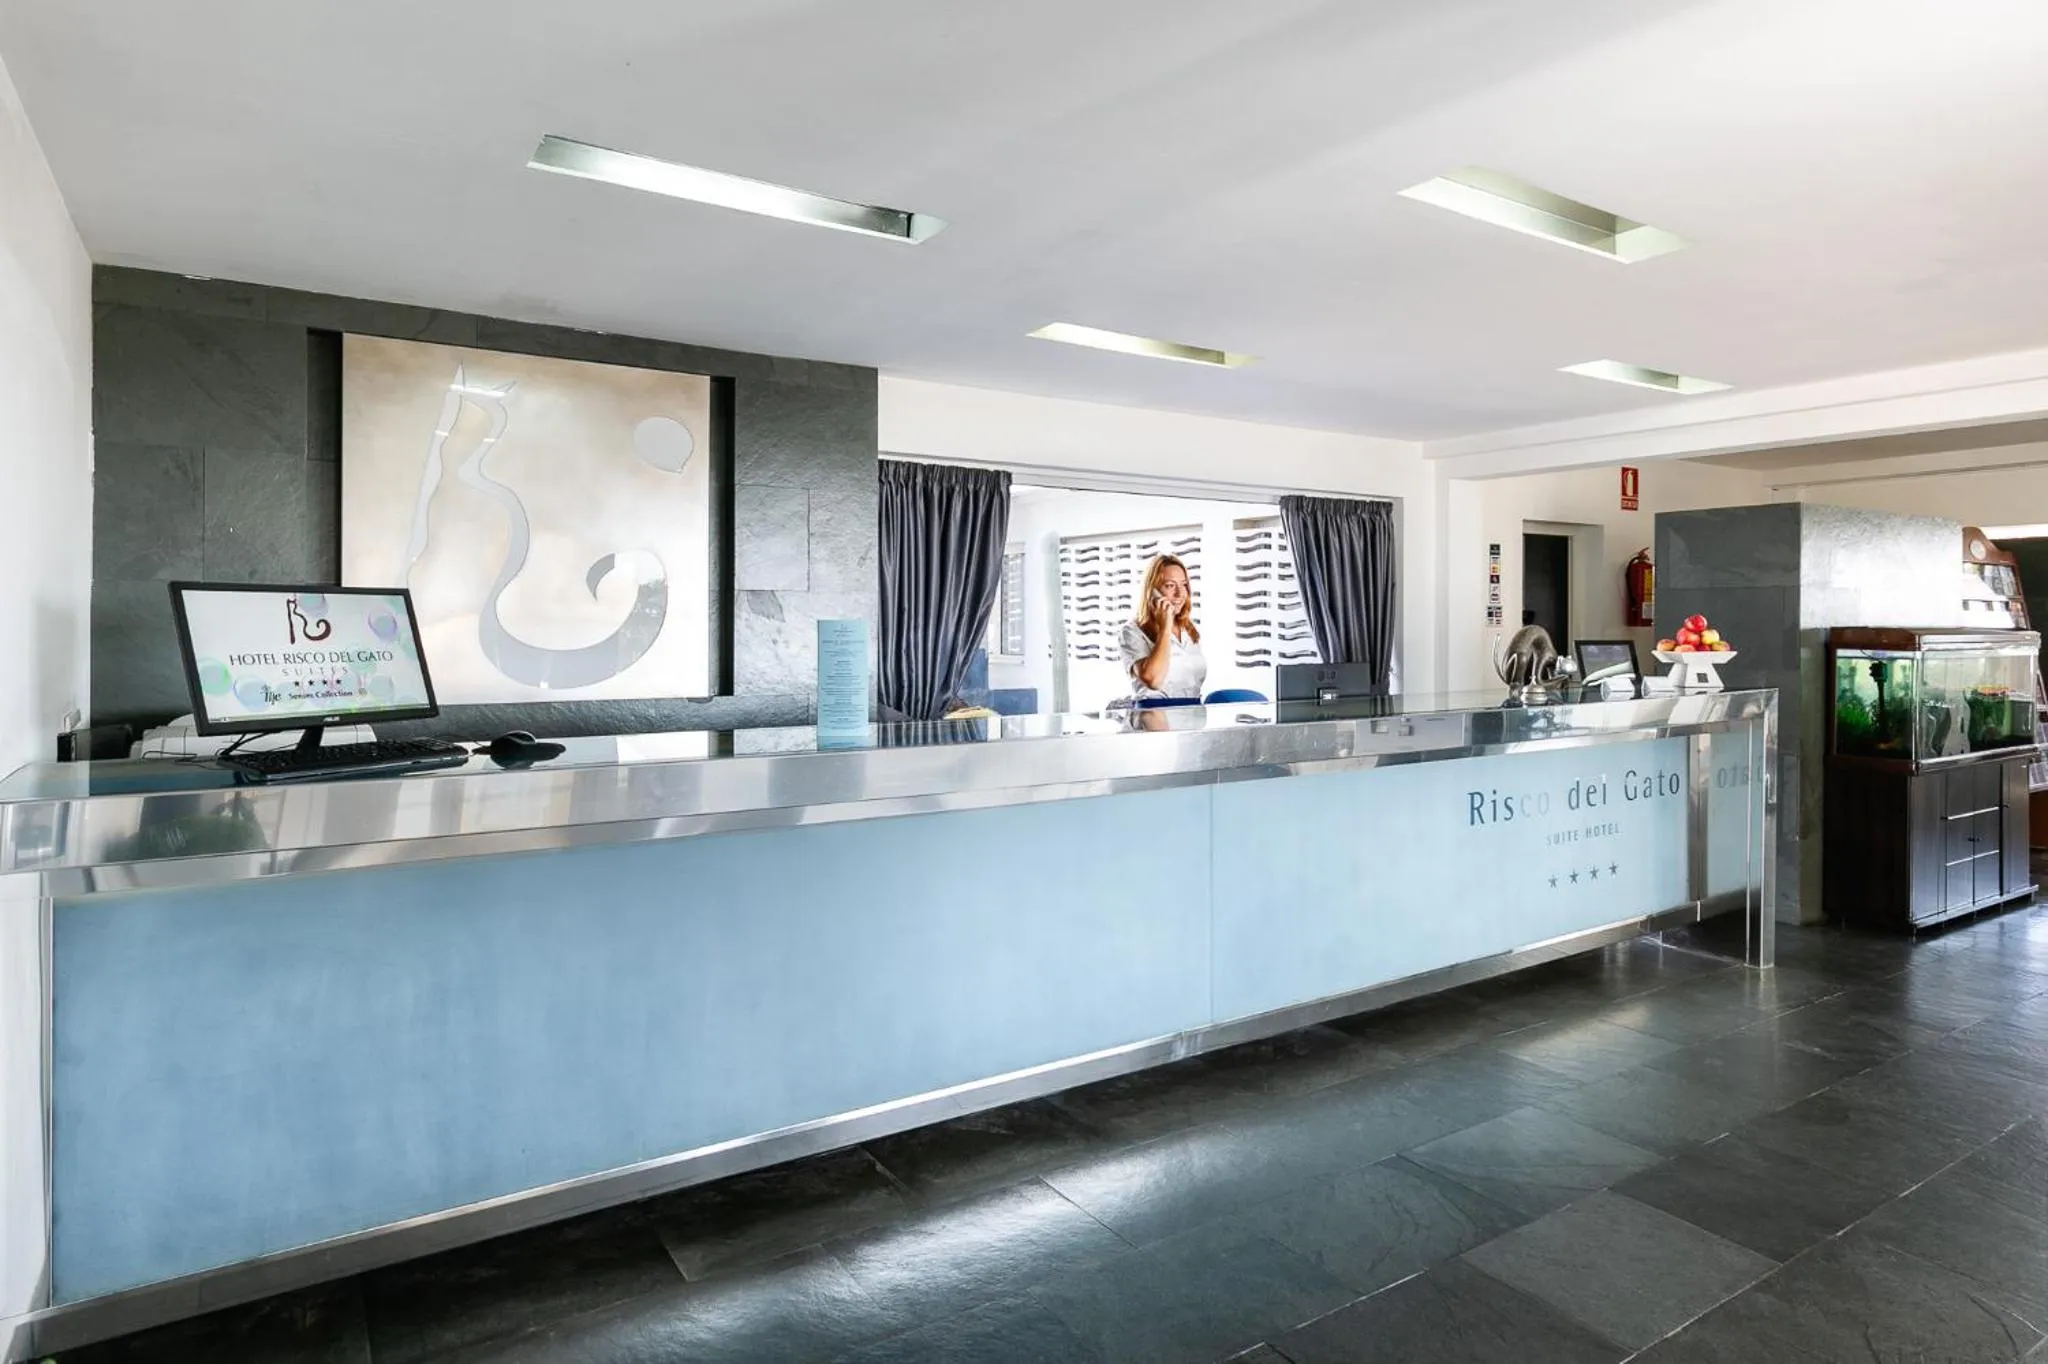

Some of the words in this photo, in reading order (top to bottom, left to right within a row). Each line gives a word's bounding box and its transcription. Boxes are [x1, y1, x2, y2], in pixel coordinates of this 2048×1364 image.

[229, 653, 279, 666] HOTEL
[283, 652, 326, 665] RISCO
[329, 651, 352, 663] DEL
[357, 650, 393, 662] GATO
[1467, 789, 1550, 826] Risco
[1568, 774, 1607, 810] del
[1624, 770, 1680, 801] Gato
[1547, 829, 1579, 846] SUITE
[1585, 823, 1620, 839] HOTEL
